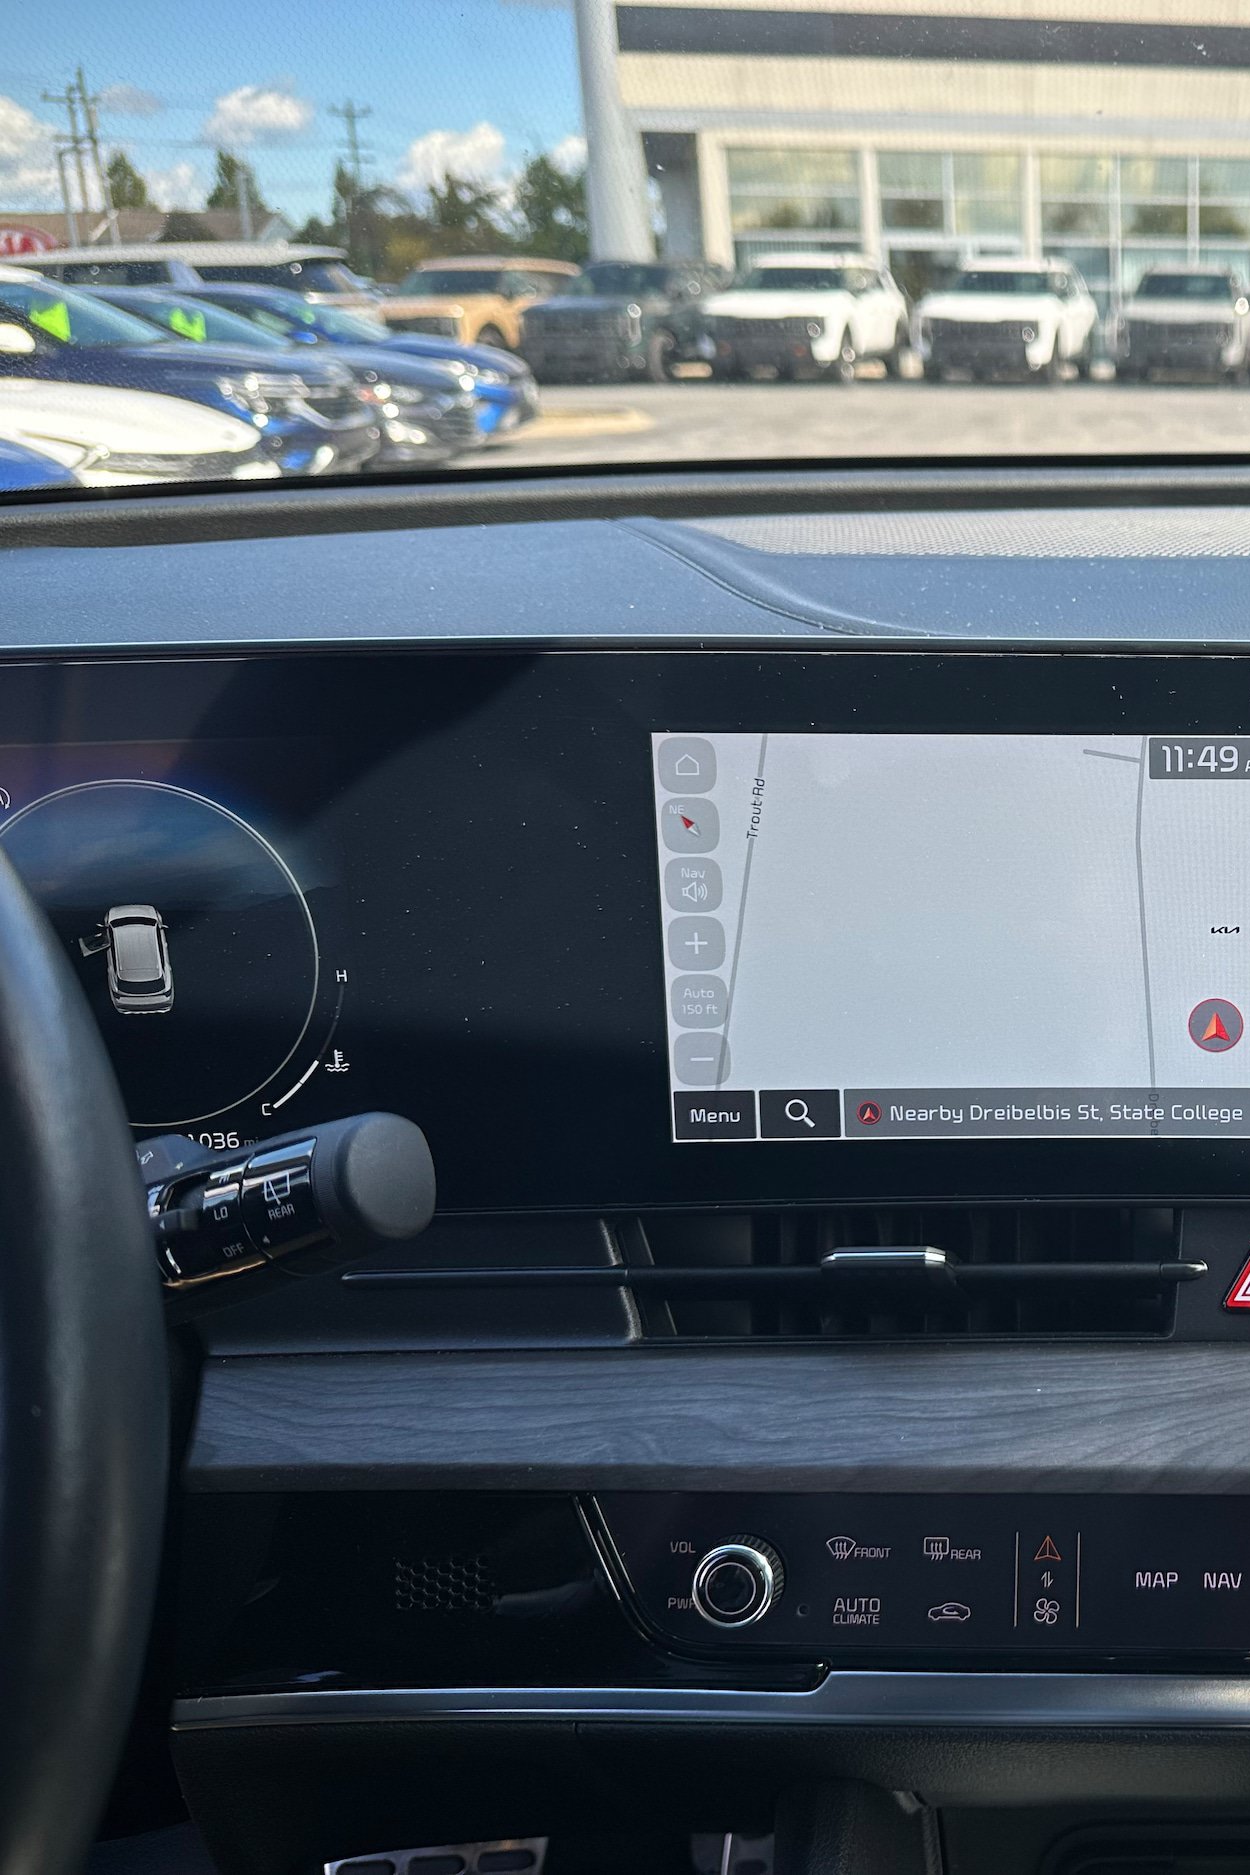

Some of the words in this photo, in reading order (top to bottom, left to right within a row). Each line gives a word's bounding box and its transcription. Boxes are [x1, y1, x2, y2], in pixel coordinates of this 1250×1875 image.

[1161, 745, 1239, 773] 11:49
[752, 778, 766, 797] Rd
[669, 804, 685, 815] NE
[746, 800, 763, 839] Trout
[681, 867, 706, 879] Nav
[335, 969, 348, 983] H
[683, 987, 715, 999] Auto
[681, 1004, 703, 1015] 150
[706, 1004, 718, 1015] ft
[261, 1103, 272, 1116] C
[690, 1108, 741, 1123] Menu
[890, 1105, 963, 1123] Nearby
[970, 1104, 1071, 1121] Dreibelbis
[1078, 1104, 1104, 1122] St,
[1110, 1104, 1165, 1120] State
[1171, 1104, 1243, 1123] College
[213, 1206, 229, 1221] LO
[268, 1203, 296, 1221] REAR
[223, 1242, 245, 1258] OFF
[670, 1541, 696, 1554] VOL
[854, 1546, 891, 1559] FRONT
[950, 1549, 982, 1560] REAR
[1135, 1571, 1179, 1590] MAP
[1203, 1572, 1242, 1590] NAV
[833, 1597, 881, 1613] AUTO
[832, 1613, 880, 1625] CLIMATE
